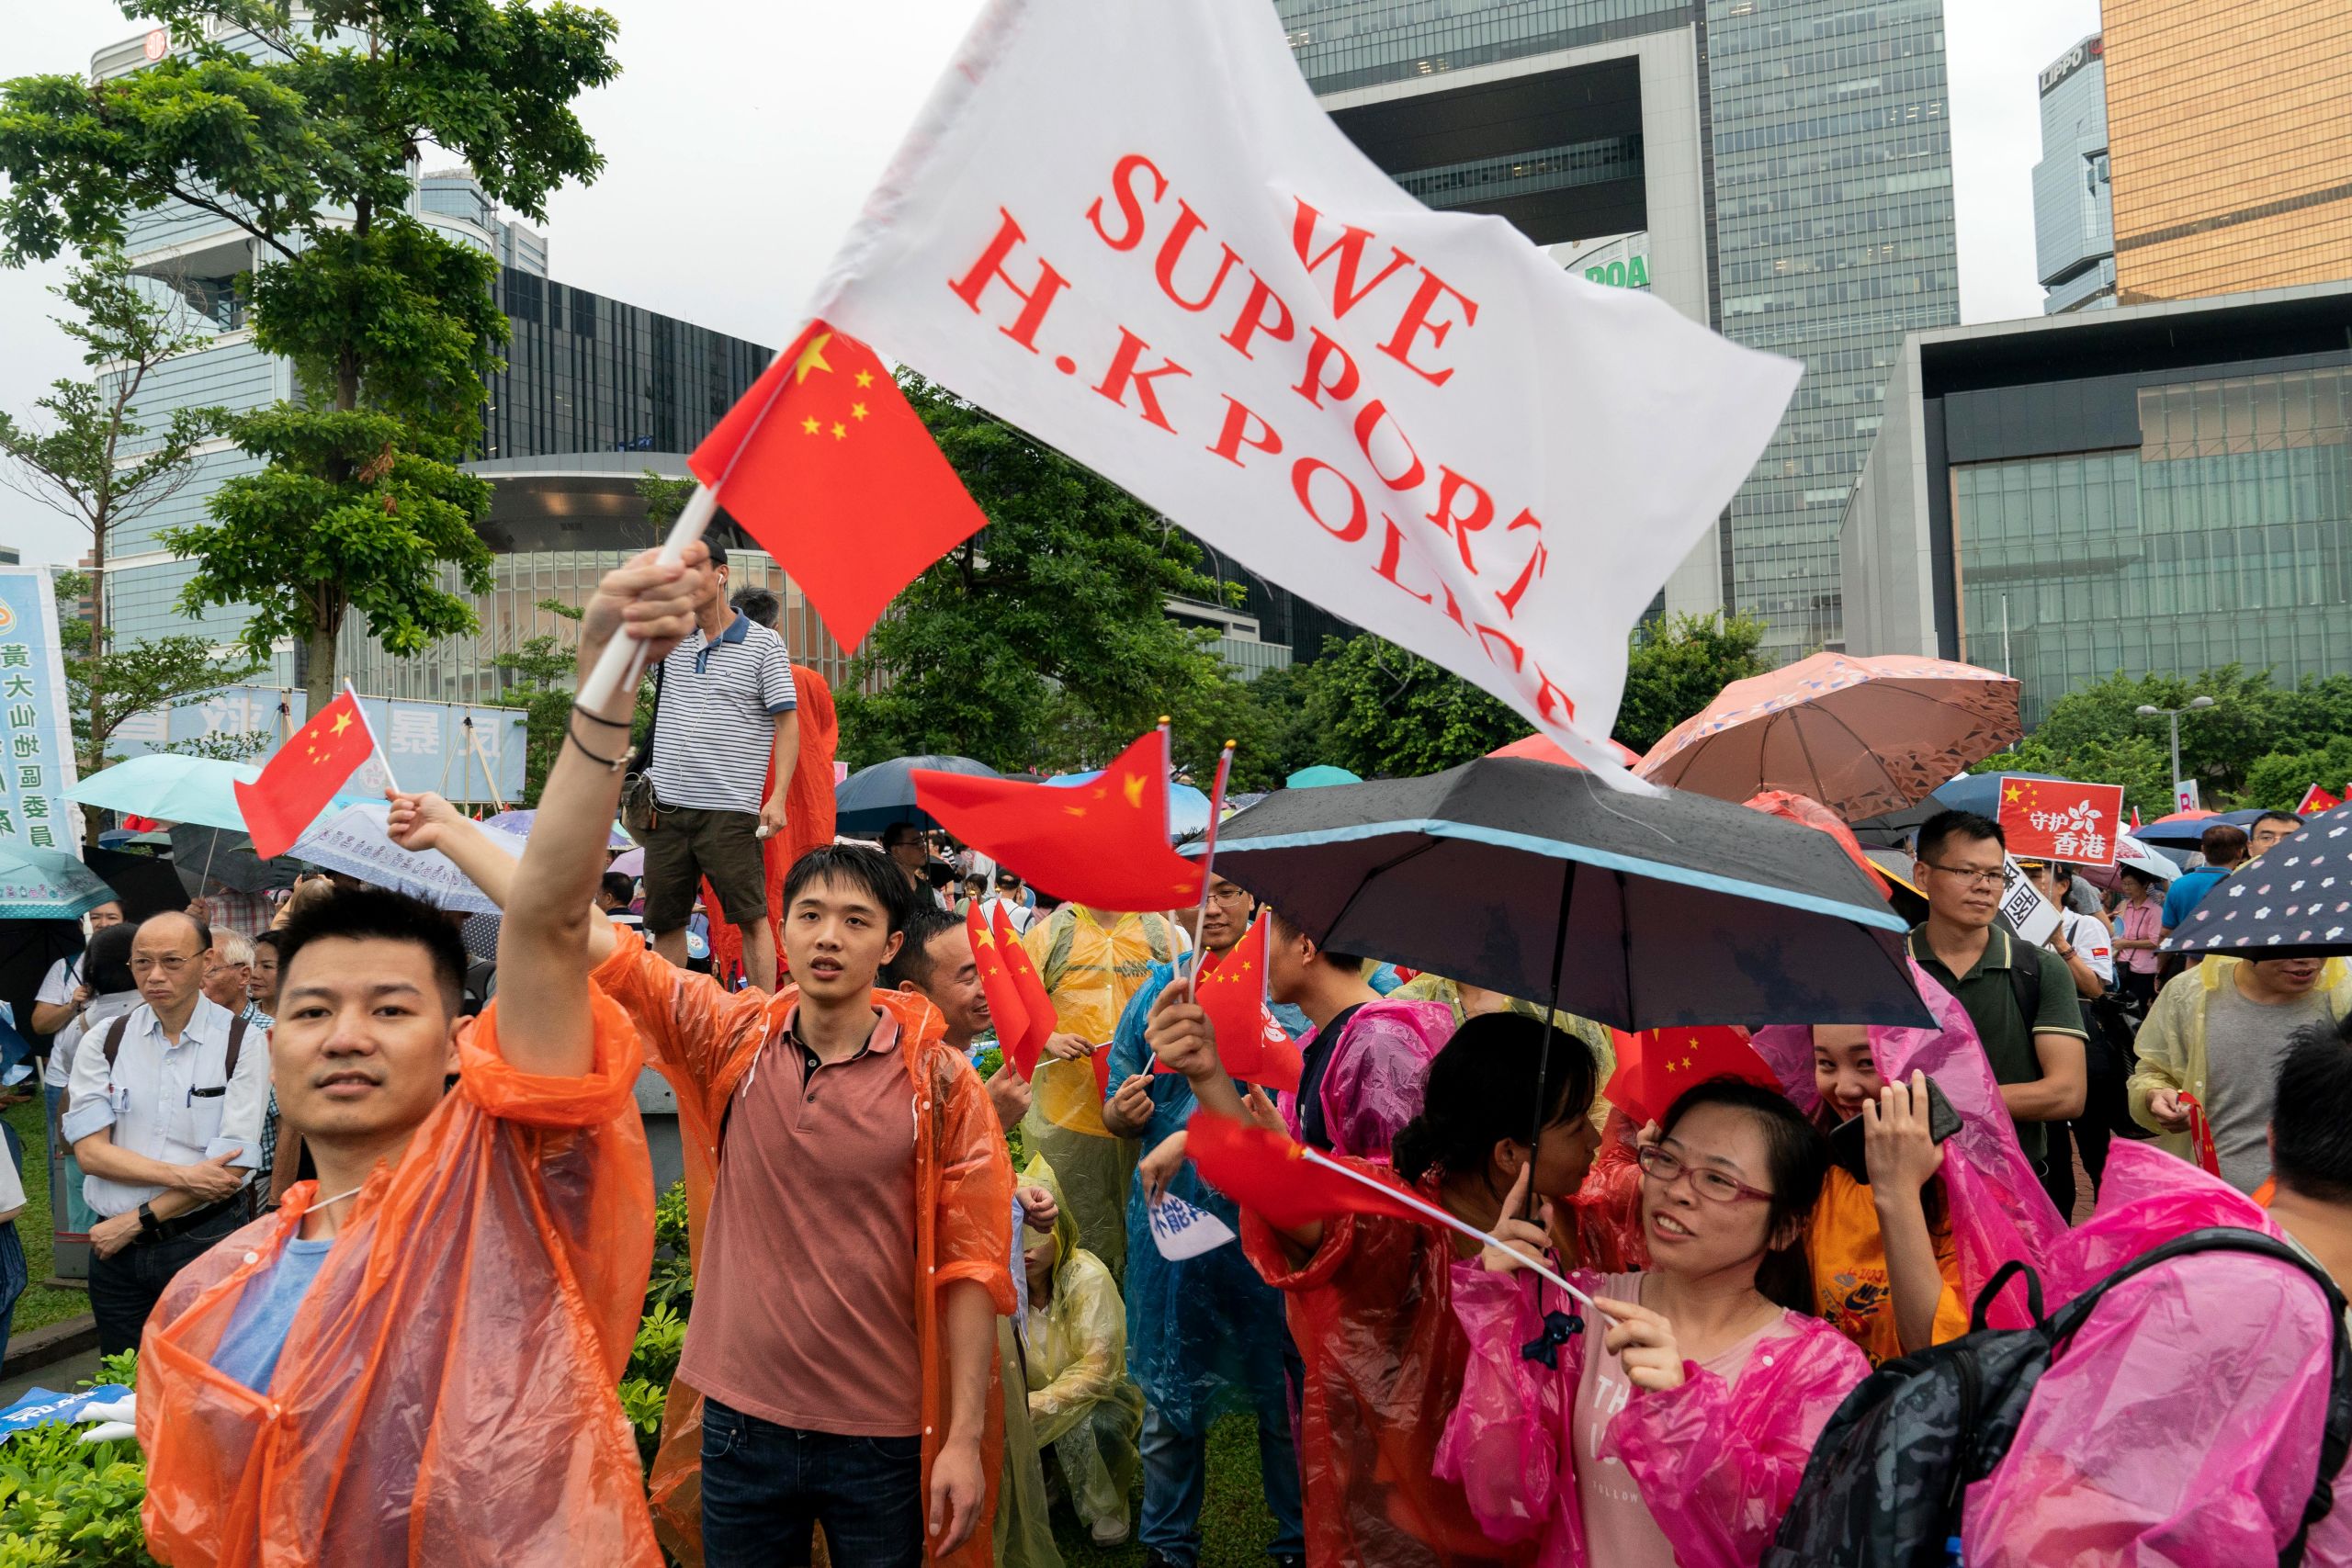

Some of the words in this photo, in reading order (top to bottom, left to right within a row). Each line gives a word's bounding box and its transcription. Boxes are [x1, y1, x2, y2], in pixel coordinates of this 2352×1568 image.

[166, 13, 222, 51] CIC
[2041, 47, 2083, 92] LIPPO
[1293, 195, 1479, 387] WE
[1085, 153, 1548, 619] SUPPORT
[2030, 811, 2069, 832] 守护
[2052, 831, 2106, 859] 香港
